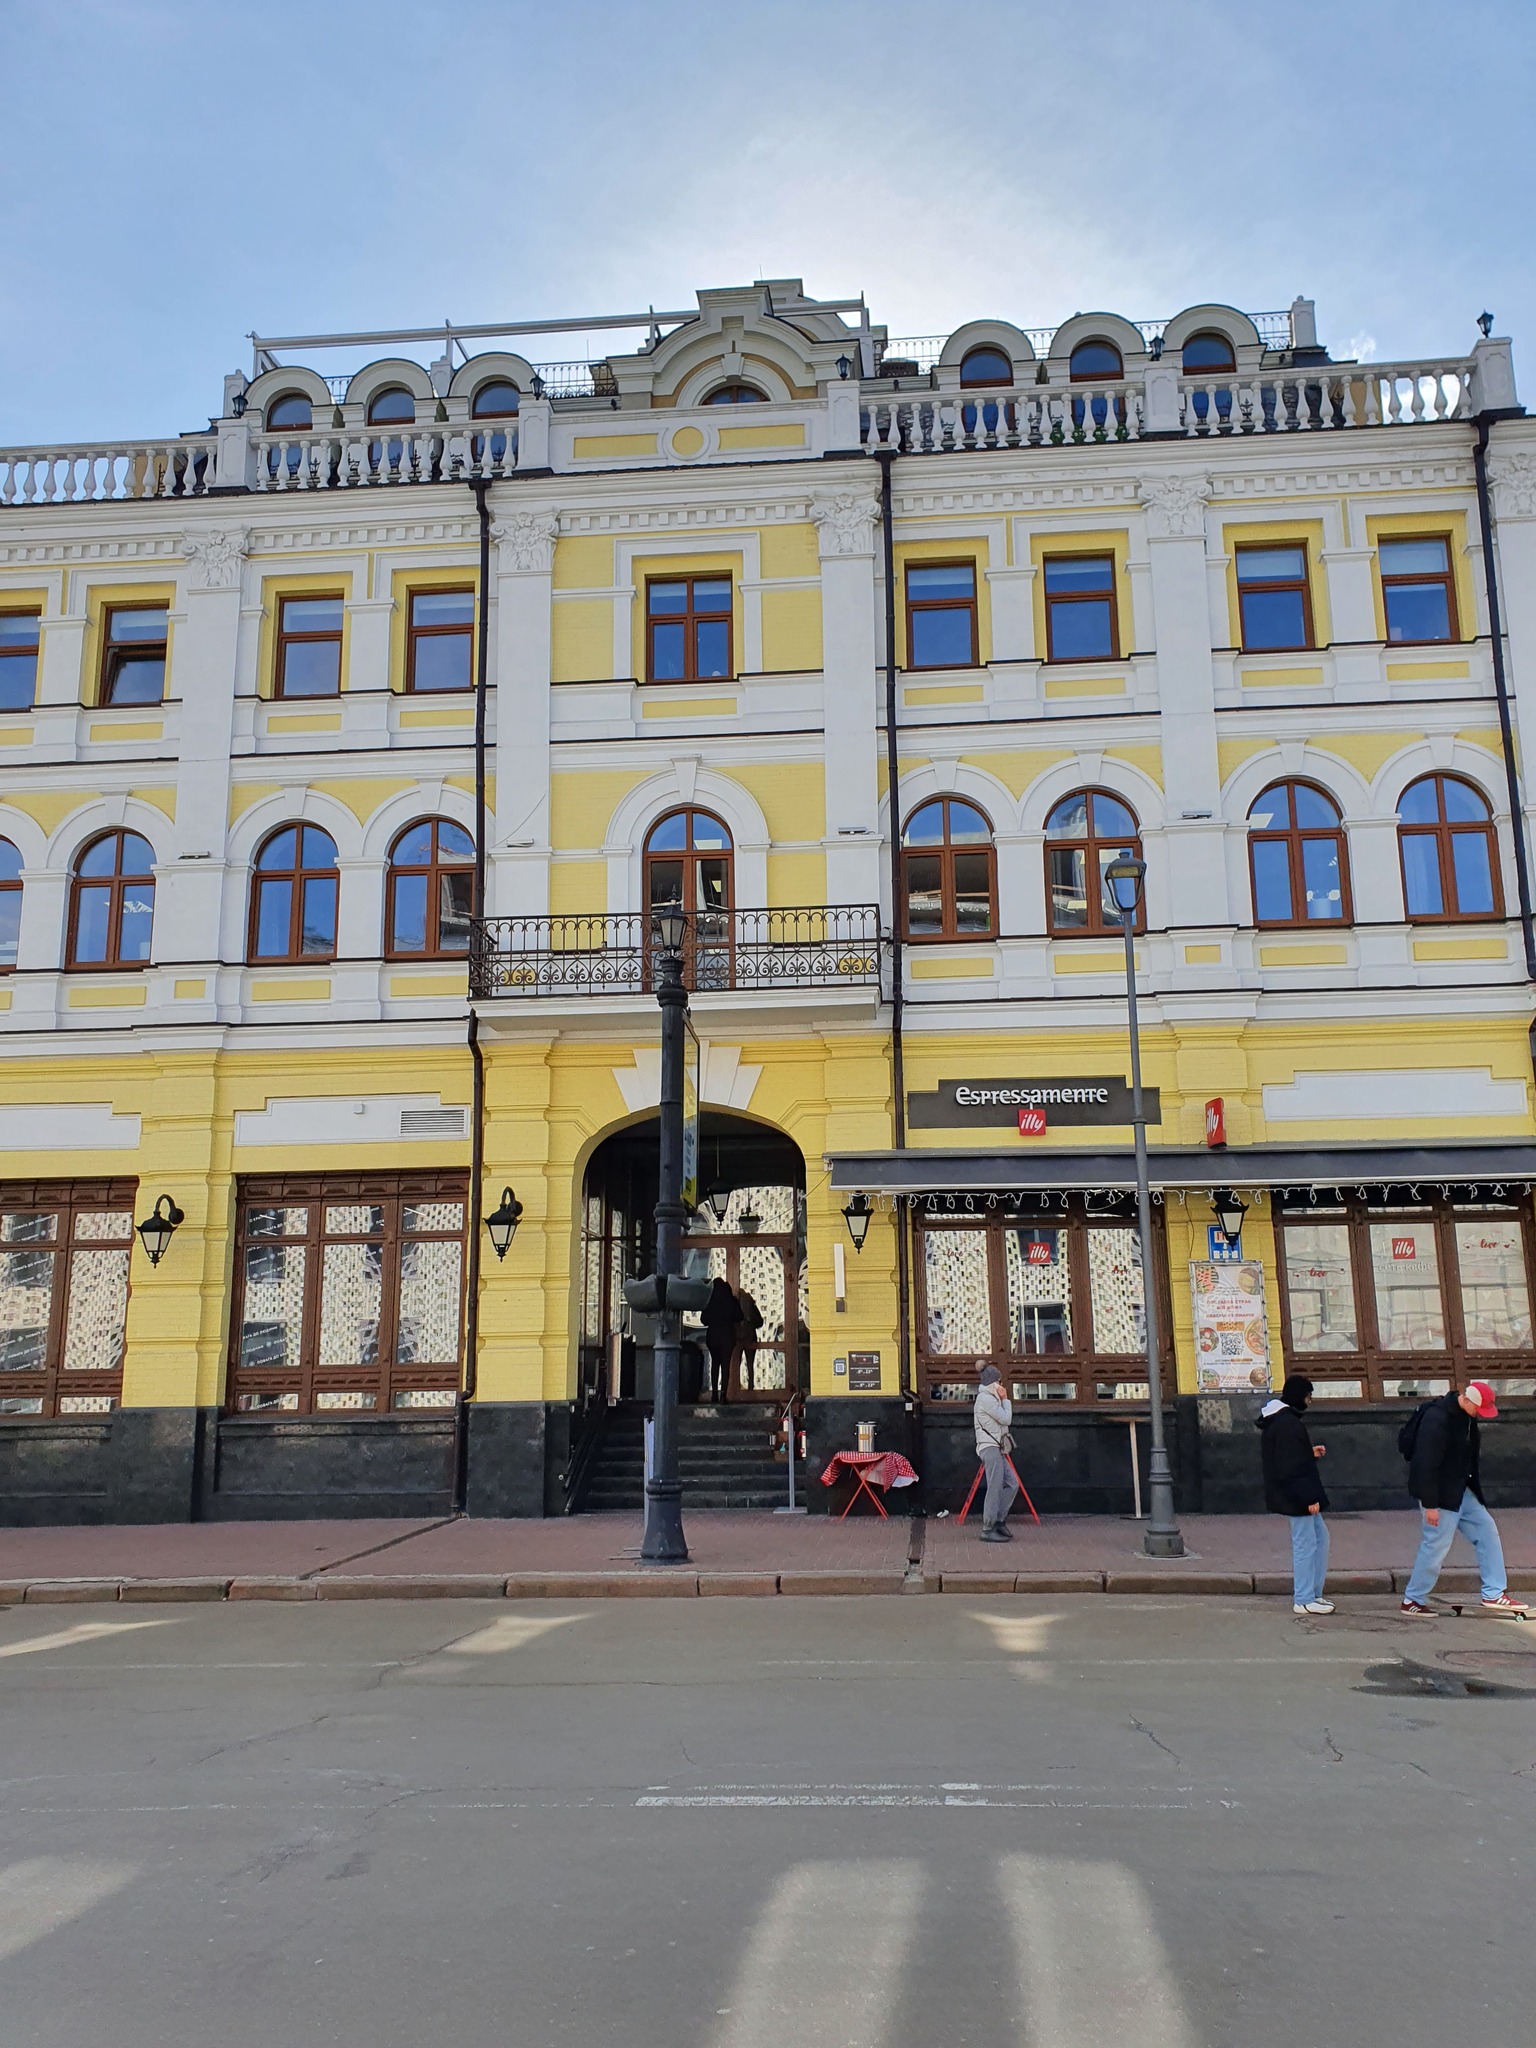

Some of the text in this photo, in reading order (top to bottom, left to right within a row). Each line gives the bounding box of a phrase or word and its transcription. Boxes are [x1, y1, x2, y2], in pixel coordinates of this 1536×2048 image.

[1020, 1114, 1044, 1133] illy
[1394, 1241, 1414, 1257] illy
[1480, 1238, 1498, 1249] love
[1030, 1245, 1049, 1262] illy
[1309, 1267, 1328, 1277] love
